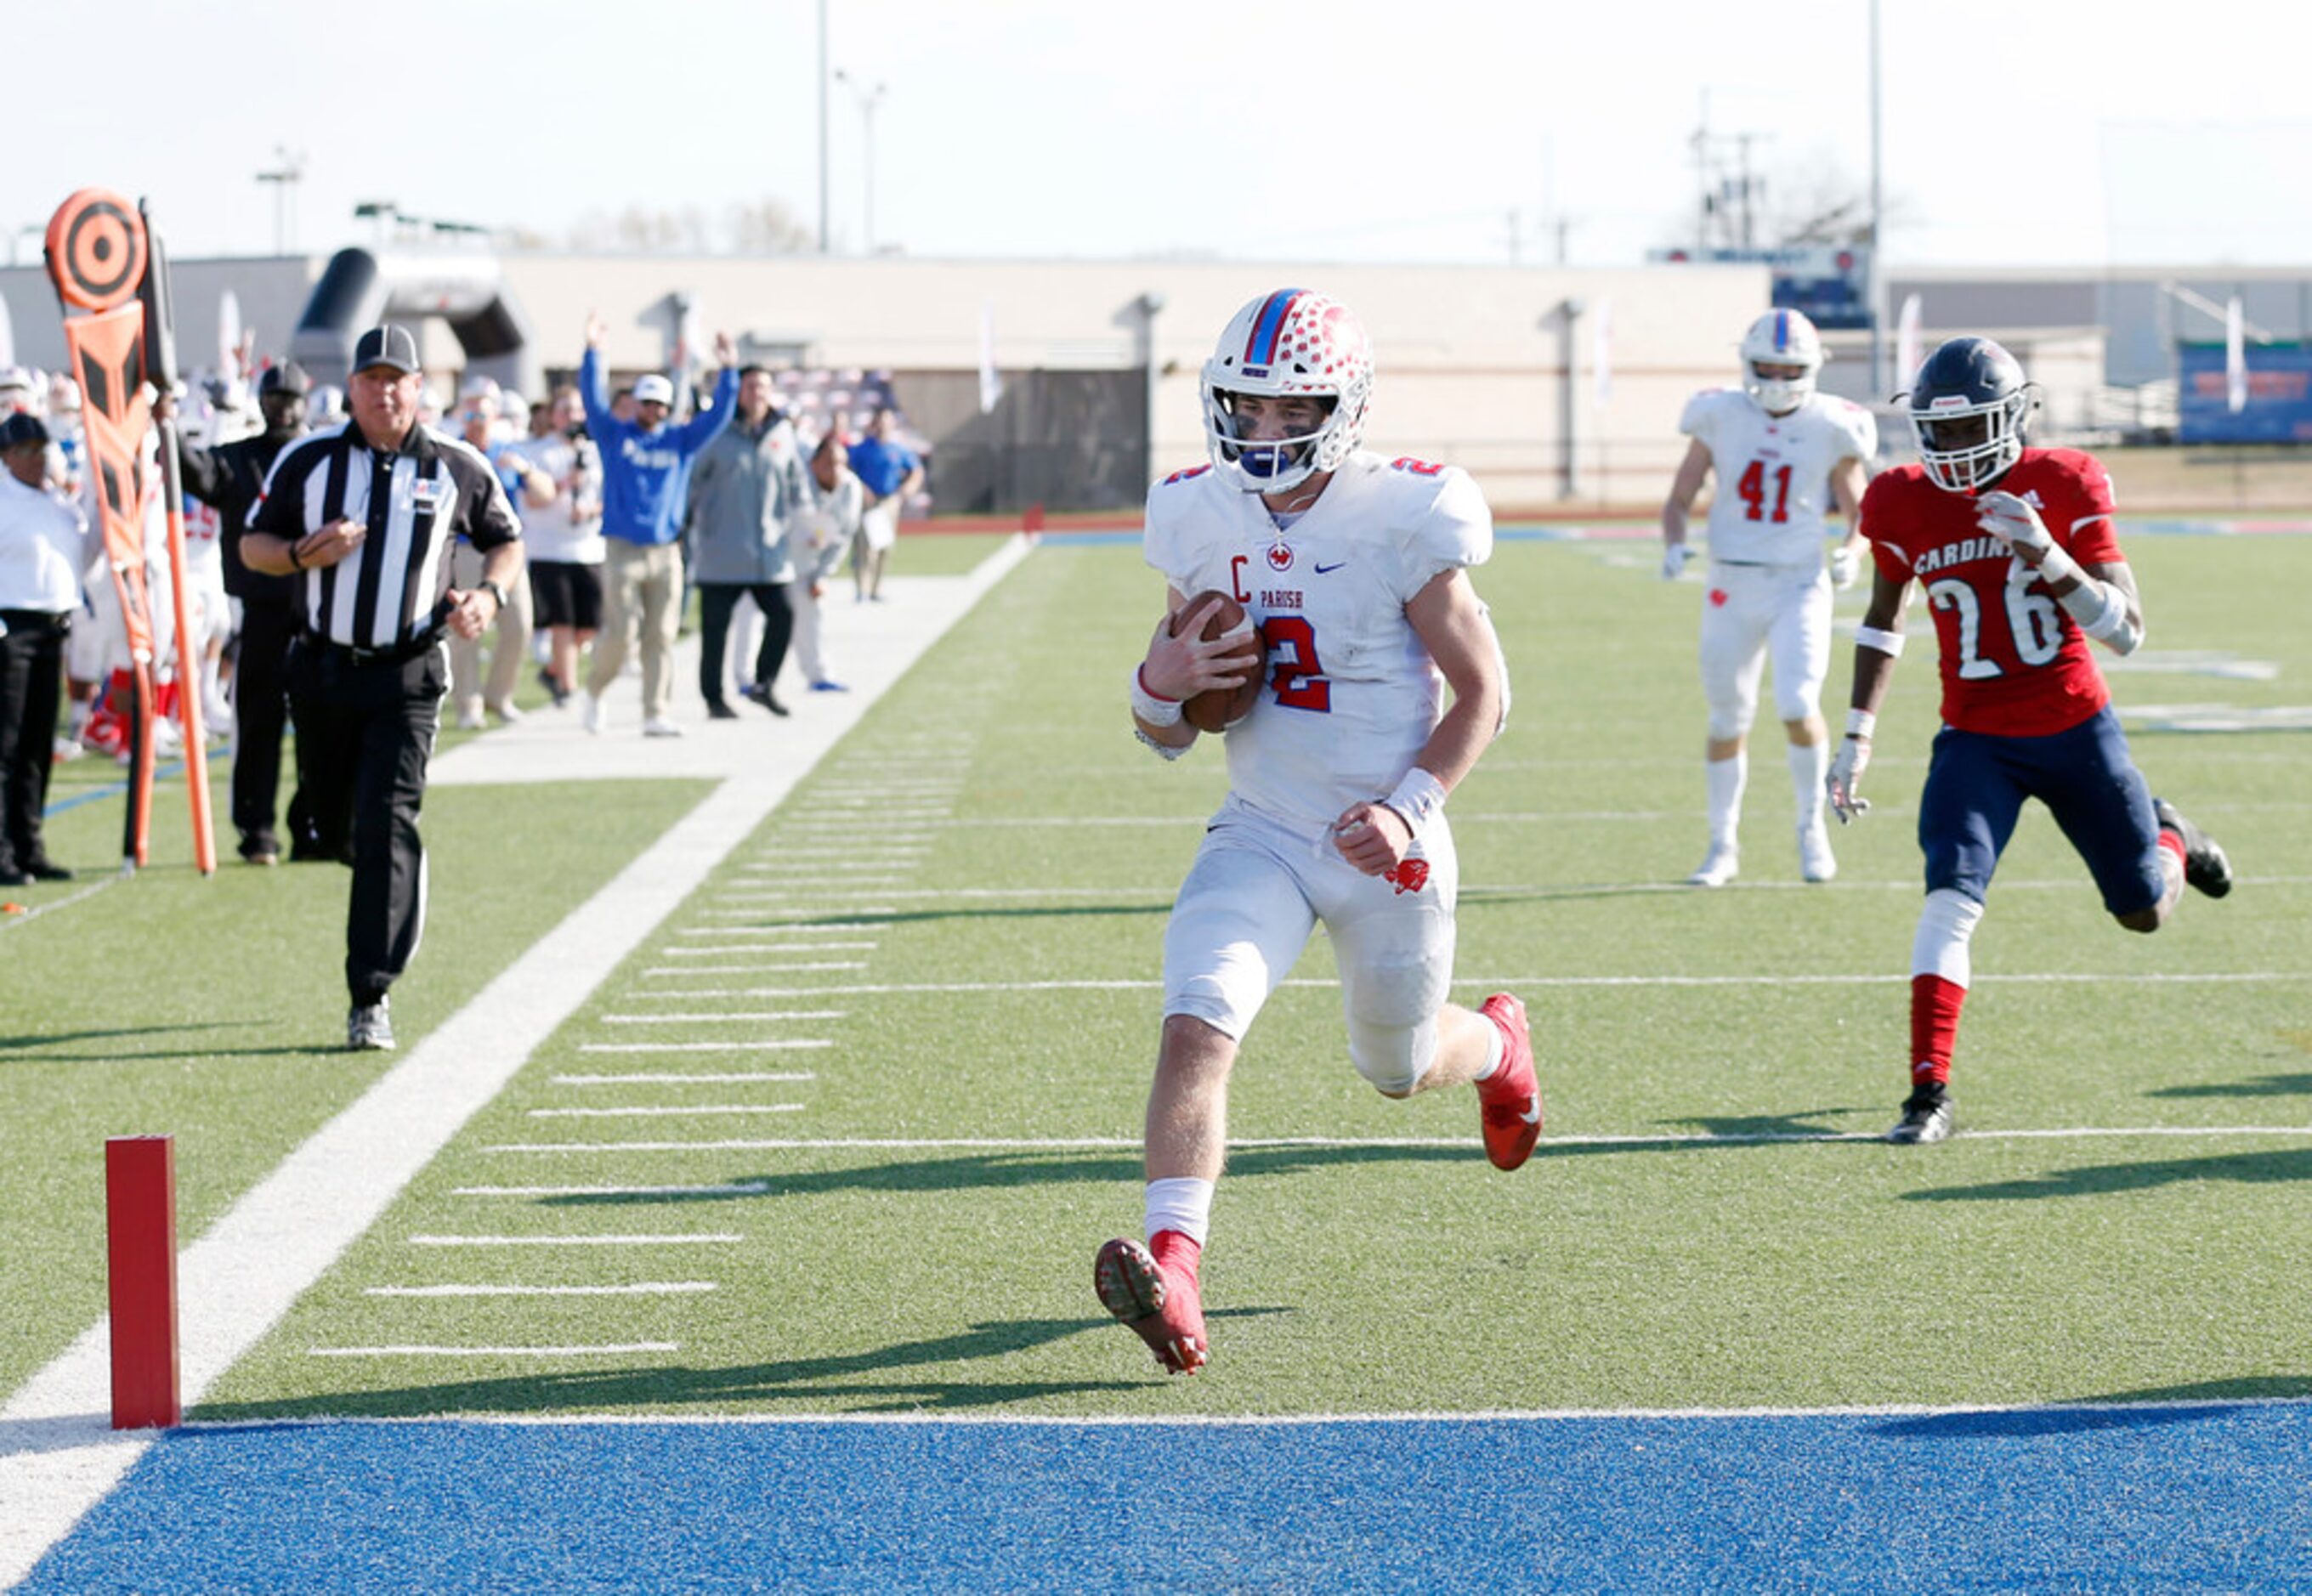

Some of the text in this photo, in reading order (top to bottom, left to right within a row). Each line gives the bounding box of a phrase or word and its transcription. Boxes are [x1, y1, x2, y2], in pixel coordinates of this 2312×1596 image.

[1737, 460, 1793, 524] 41
[1231, 555, 1251, 603] C
[1913, 535, 2014, 575] CARDIN
[1261, 590, 1303, 608] PARISH
[1927, 555, 2065, 680] 26
[1263, 615, 1332, 713] 2
